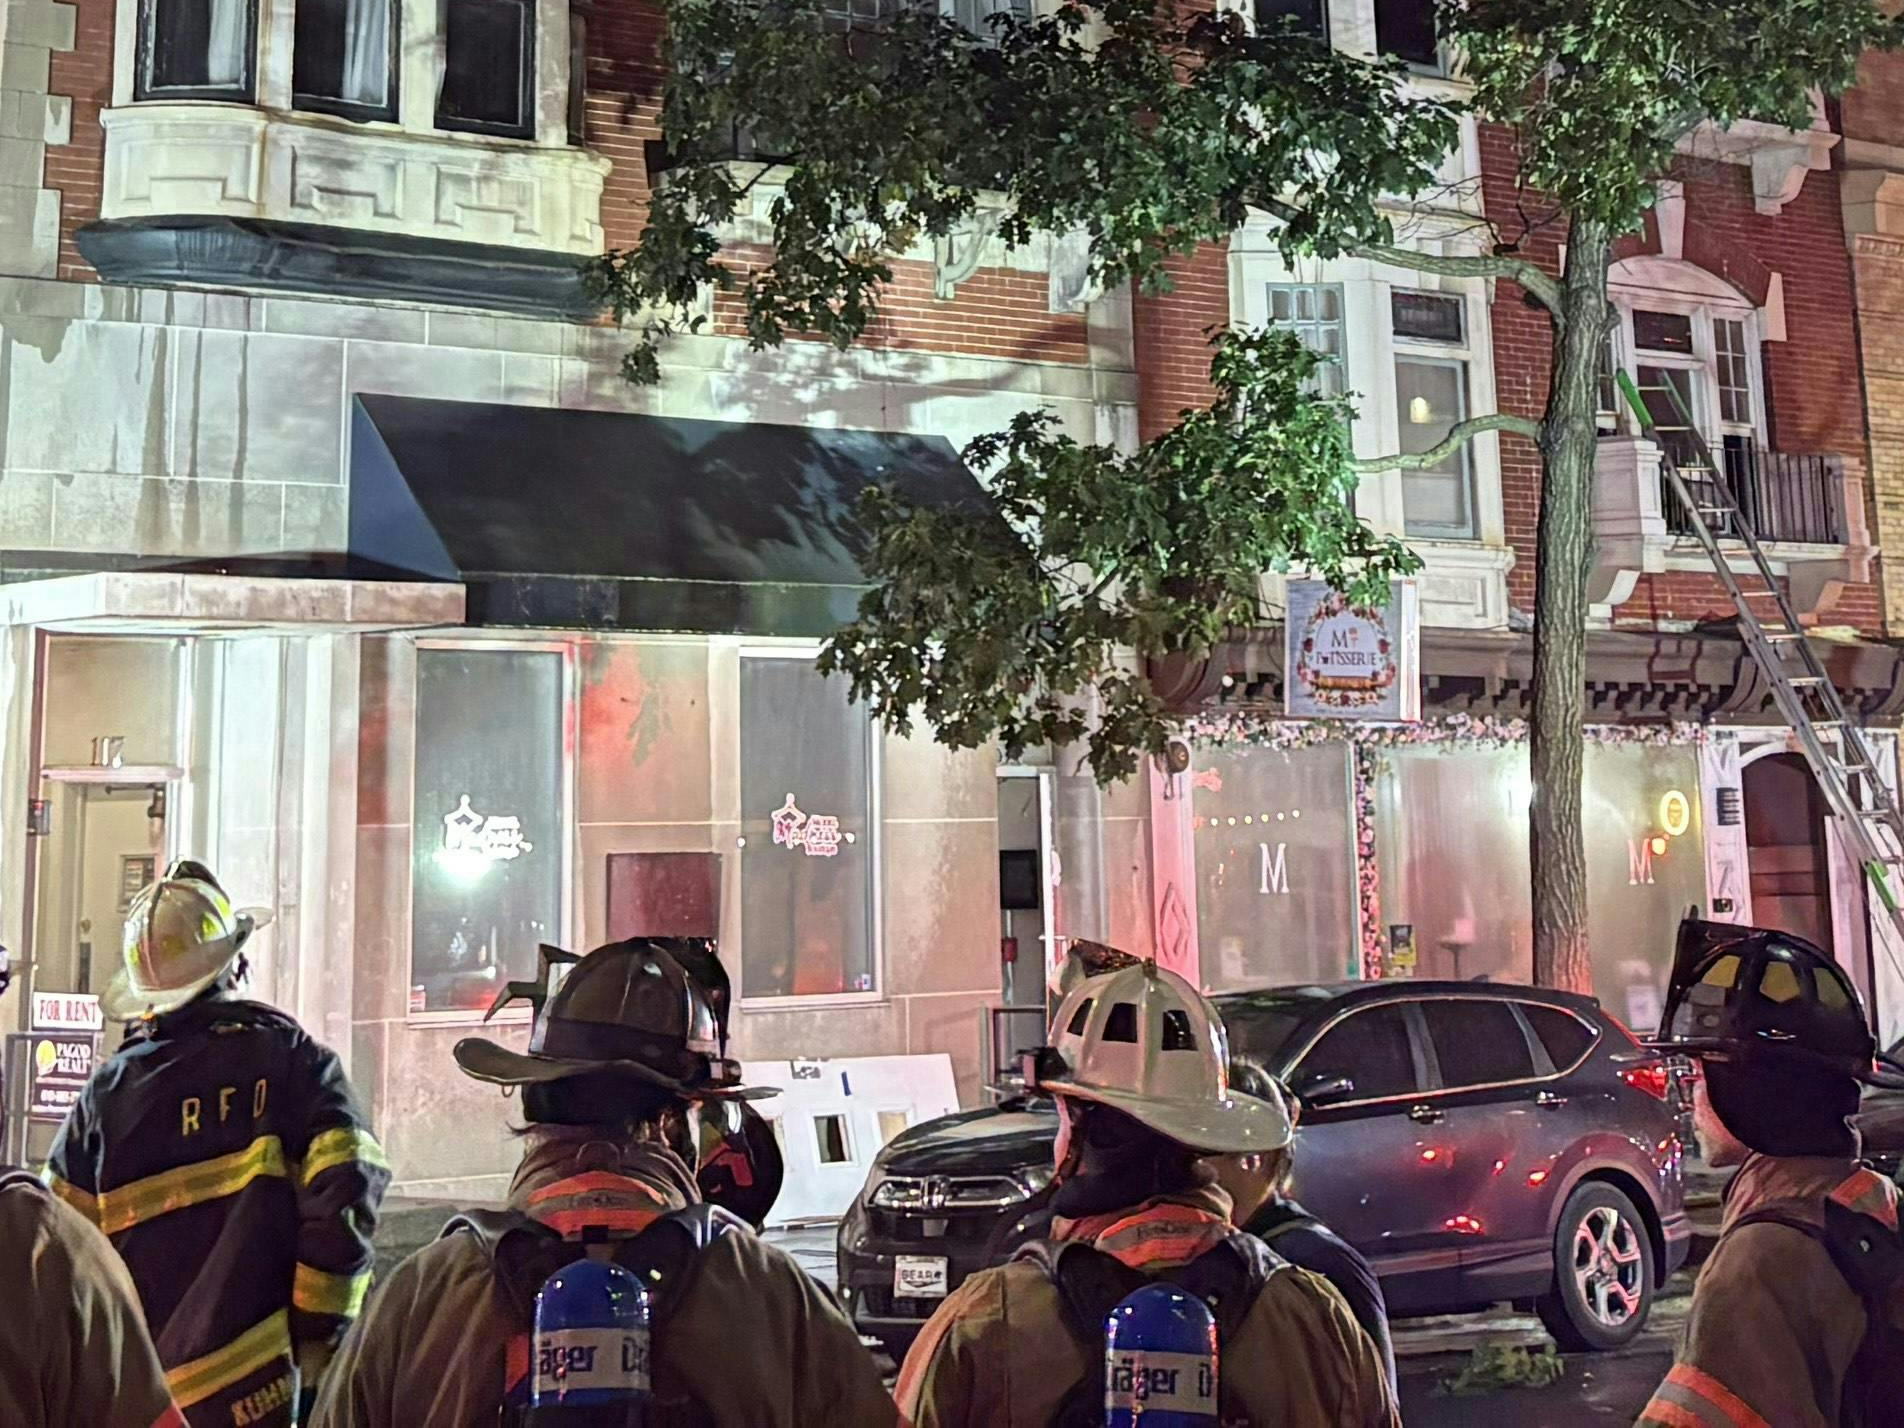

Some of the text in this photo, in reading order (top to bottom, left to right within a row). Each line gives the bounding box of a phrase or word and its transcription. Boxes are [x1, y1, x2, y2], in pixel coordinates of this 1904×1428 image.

[1259, 842, 1290, 894] M
[40, 999, 97, 1023] FOR RENT
